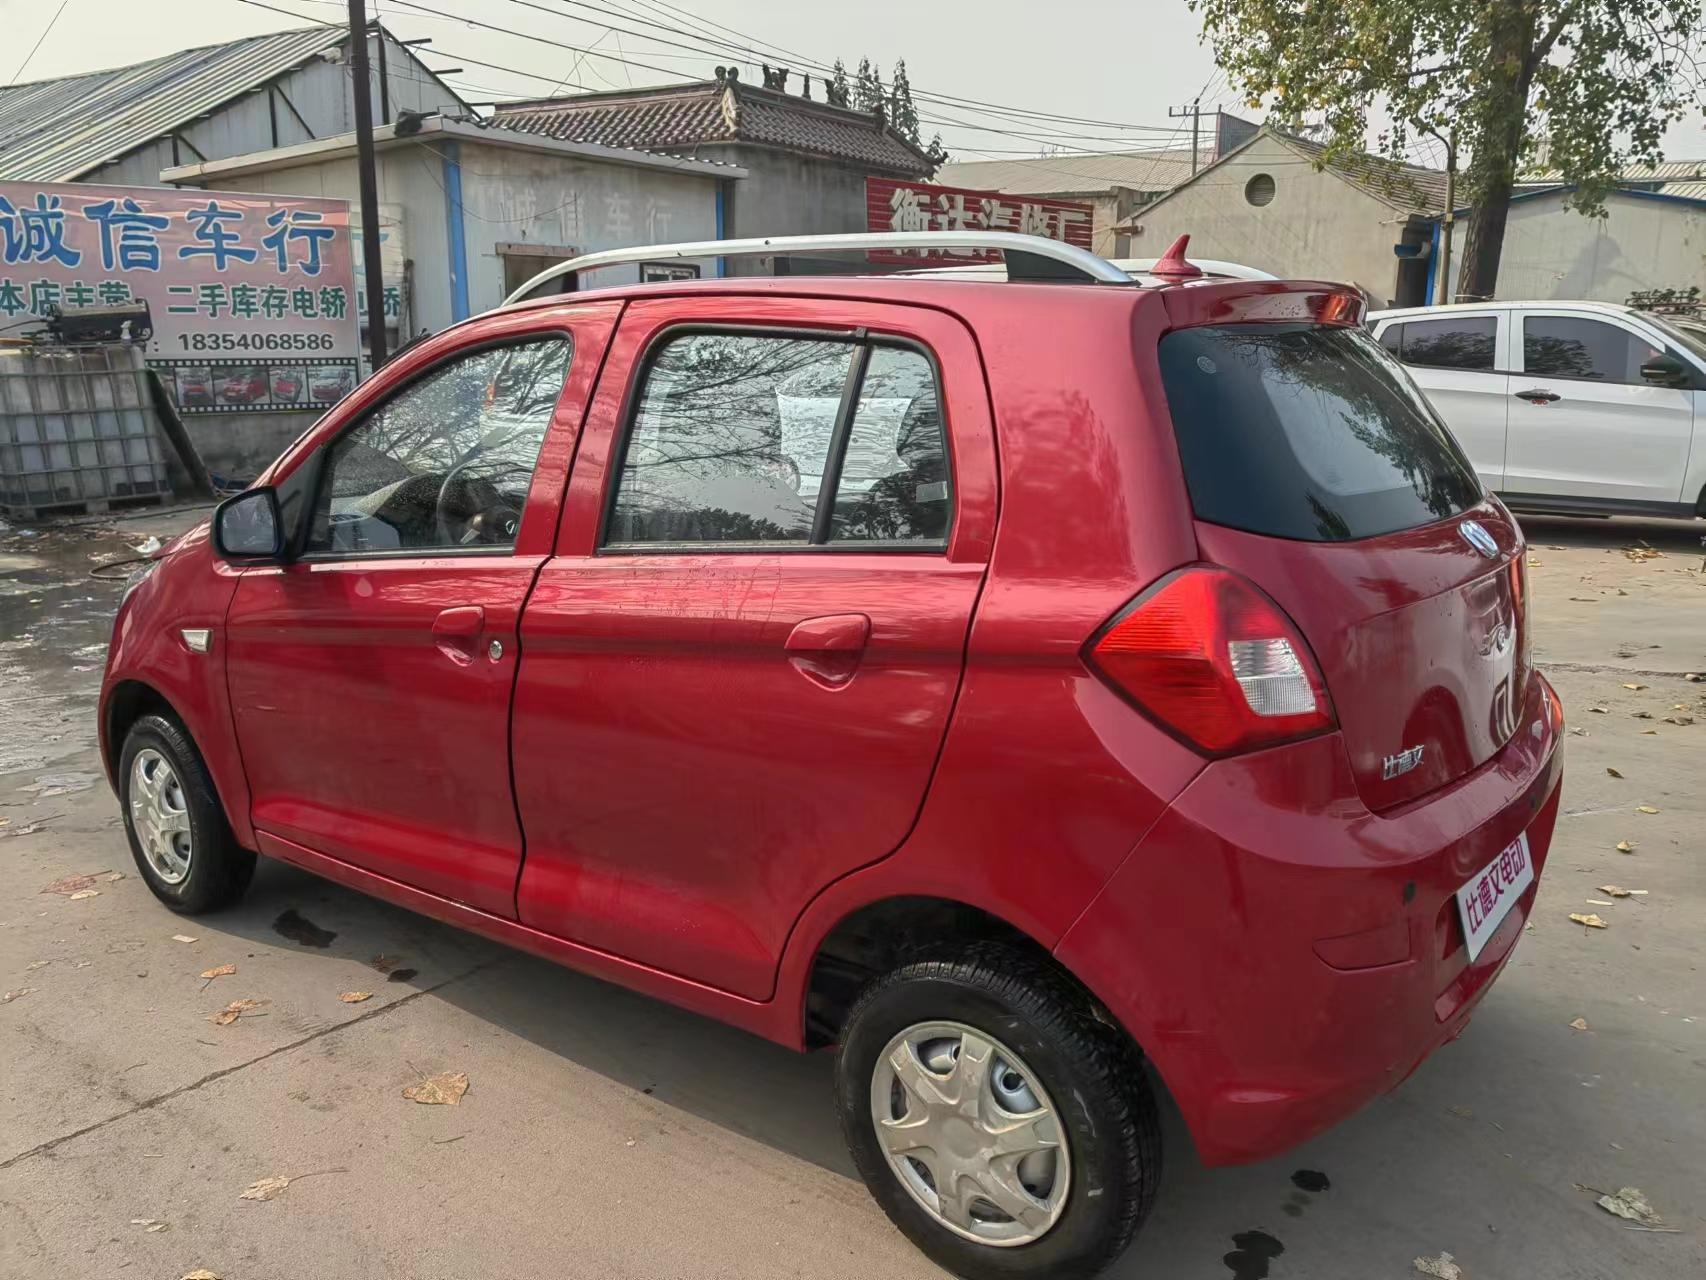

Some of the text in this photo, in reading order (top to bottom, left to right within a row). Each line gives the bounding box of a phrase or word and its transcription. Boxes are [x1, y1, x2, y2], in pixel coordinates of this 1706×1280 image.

[0, 192, 337, 277] 诚信车行
[167, 285, 346, 320] 二手库存电轿
[178, 334, 334, 352] 18354068586
[1383, 744, 1425, 781] 比德文
[1465, 838, 1526, 935] 比德文电动
